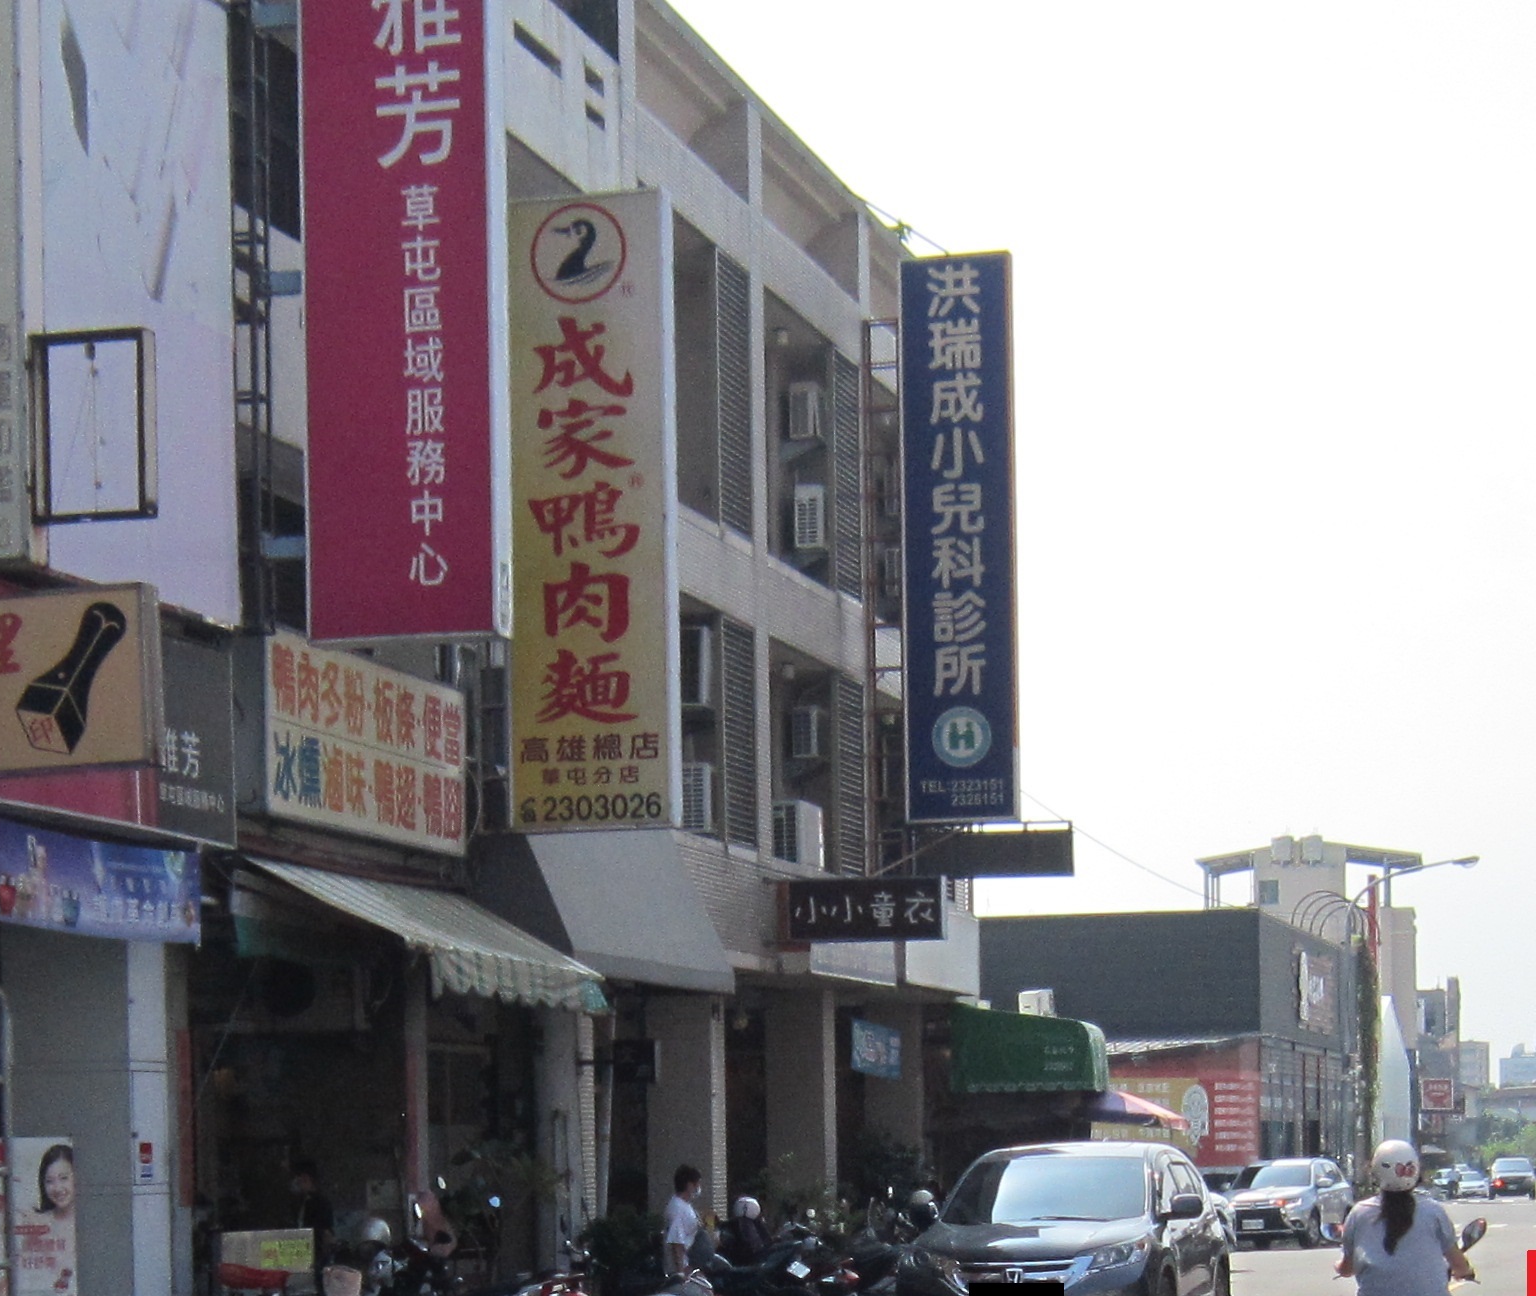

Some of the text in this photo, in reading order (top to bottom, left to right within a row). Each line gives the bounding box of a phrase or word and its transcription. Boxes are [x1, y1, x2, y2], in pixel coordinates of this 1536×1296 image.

[400, 185, 449, 587] 草屯區域服務中心
[925, 264, 986, 697] 洪瑞成小兒科診所
[527, 316, 641, 726] 成家鴨肉麵
[520, 732, 660, 764] 高雄總店
[543, 791, 662, 823] 2303026
[794, 890, 936, 928] 小小童衣
